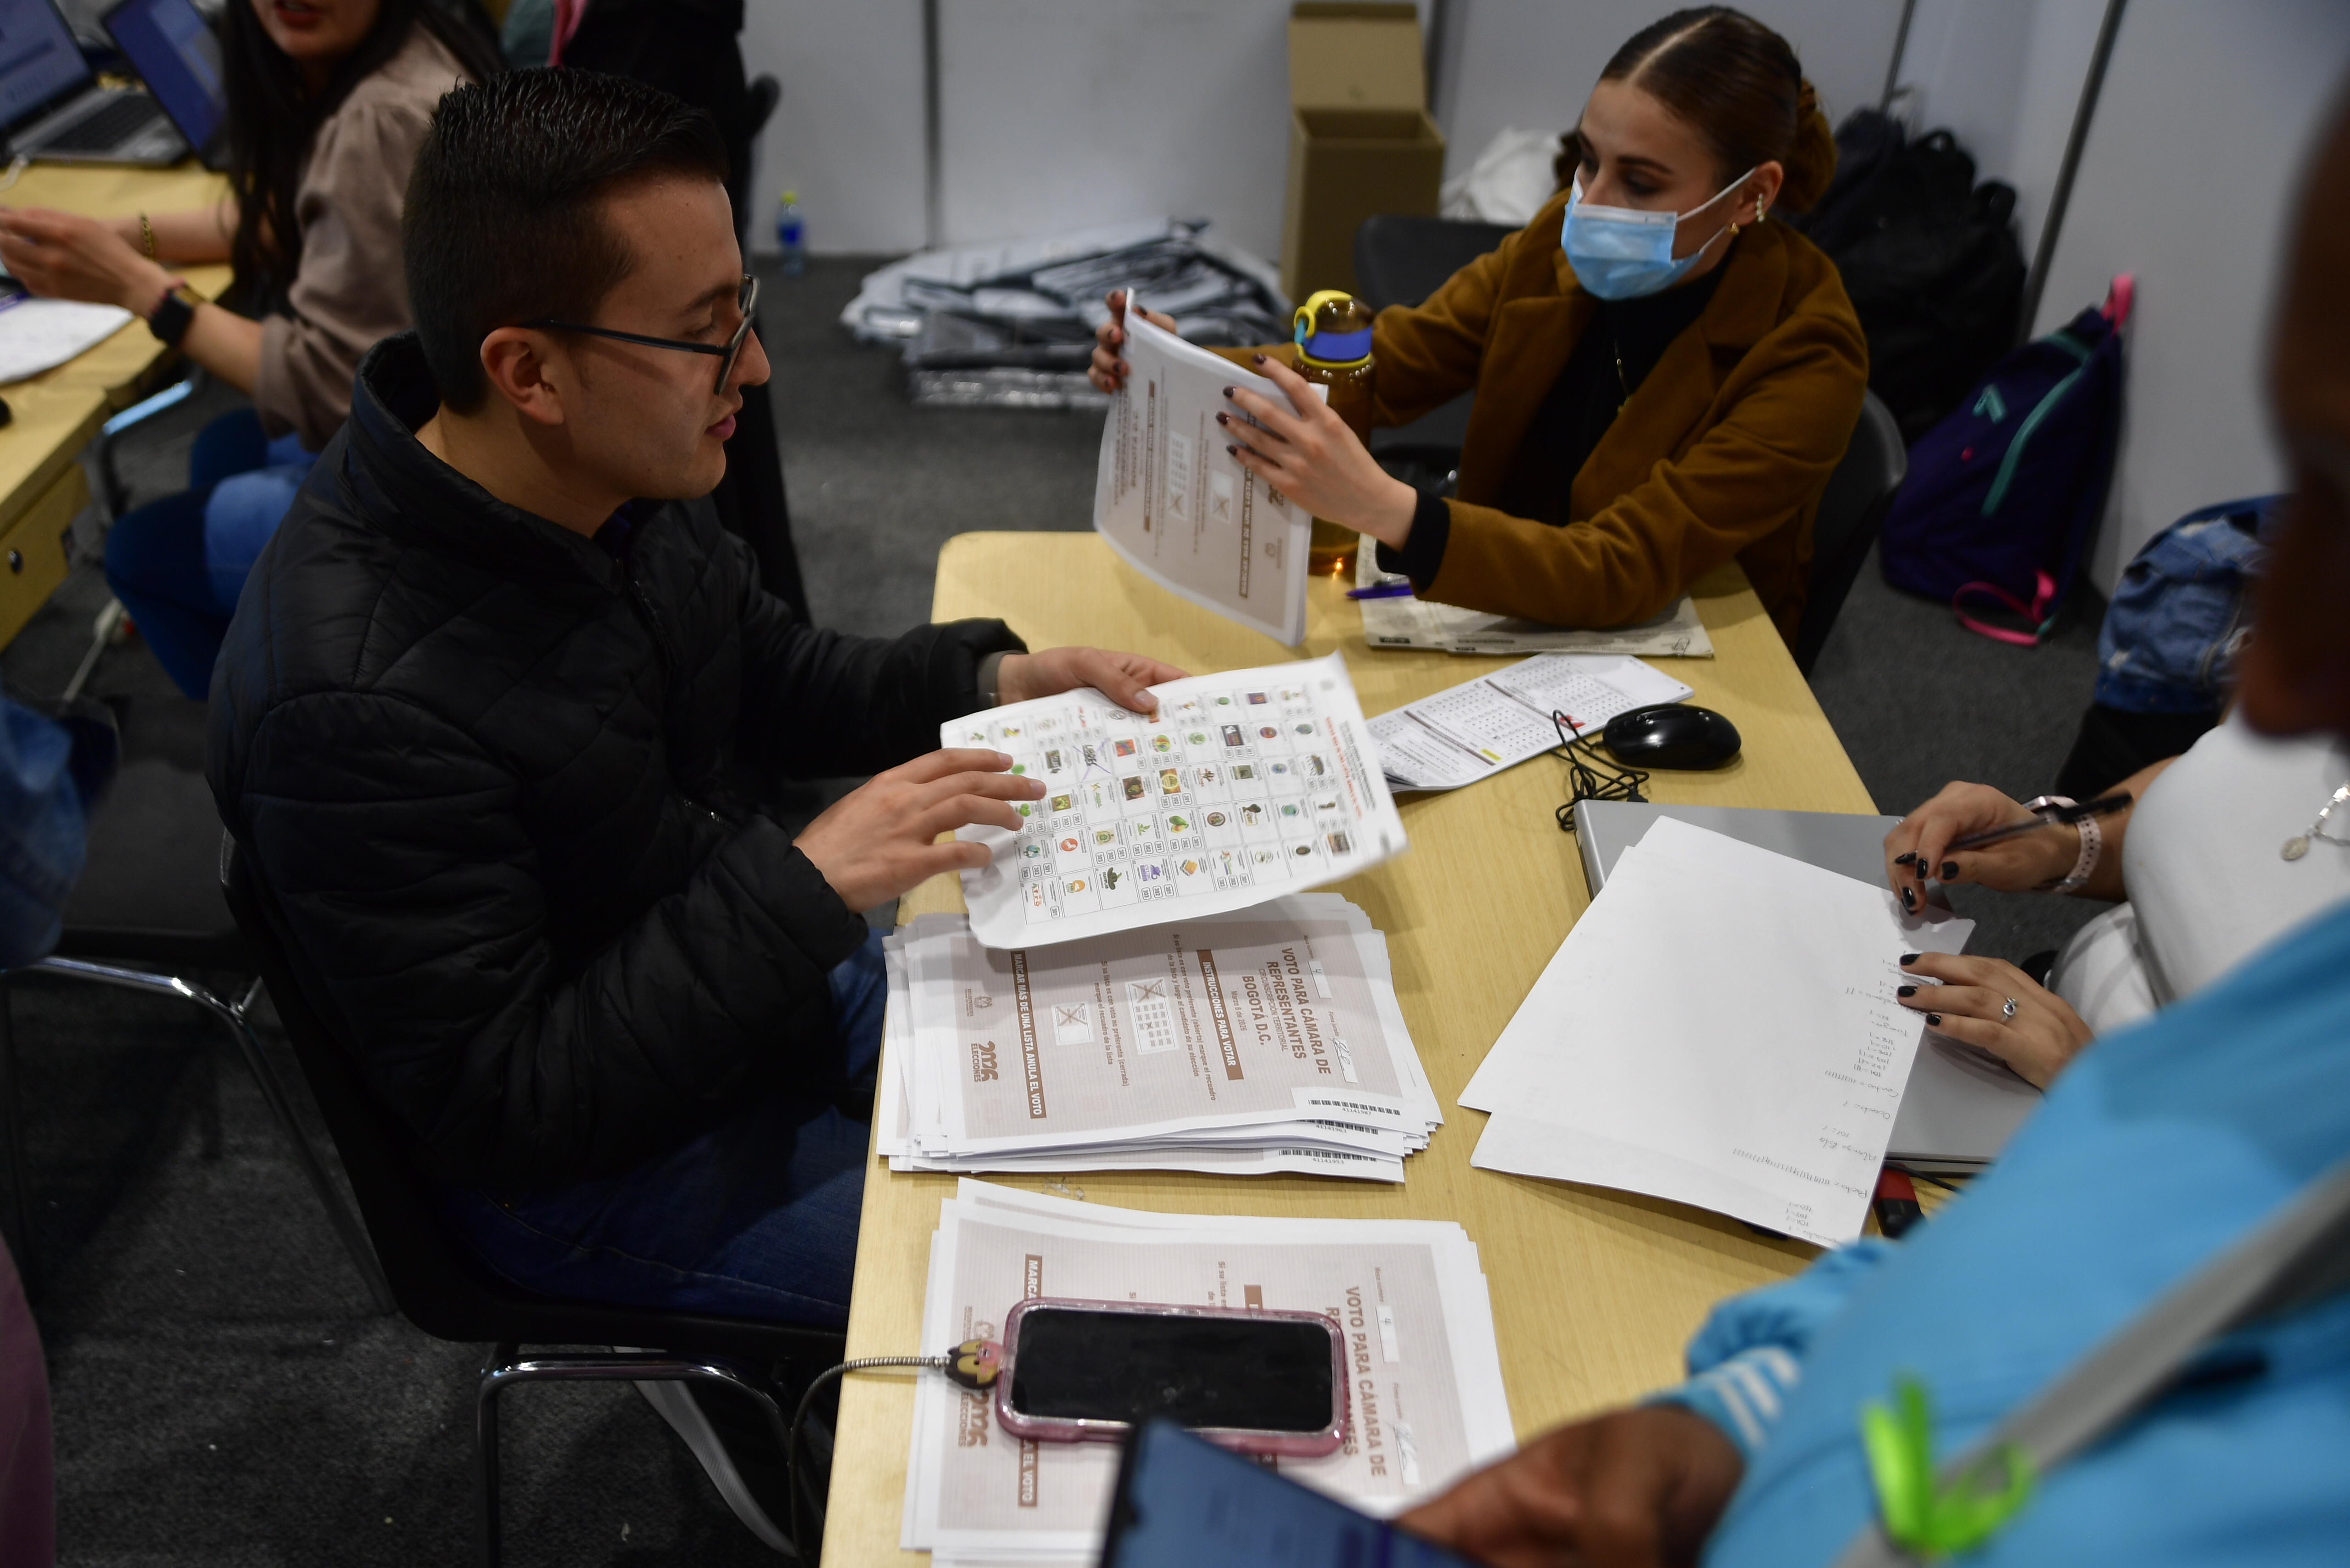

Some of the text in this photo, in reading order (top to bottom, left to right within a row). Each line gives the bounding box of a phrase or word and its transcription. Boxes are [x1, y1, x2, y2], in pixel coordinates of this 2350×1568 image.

[1014, 954, 1042, 1115] MARCAR MÁS DE UNA LISTA ANULA EL VOTO
[1099, 1010, 1108, 1035] recuadro
[1179, 1007, 1190, 1034] candidato
[1189, 1052, 1199, 1077] elección
[1203, 962, 1237, 1066] INSTRUCCIONES PARA VOTAR
[1238, 1019, 1247, 1031] 2026
[1242, 975, 1272, 1046] BOGOTÁ D.C.
[1259, 969, 1289, 1052] CIRCUNSCRIPCIÓN TERRITORIAL
[1267, 961, 1307, 1059] REPRESENTANTES
[1281, 947, 1332, 1074] VOTO PARA CÁMARA DE
[971, 1042, 981, 1082] ELECCIONES
[1112, 1028, 1123, 1058] preferente
[1118, 1059, 1129, 1086] (cerrada)
[1185, 990, 1197, 1018] preferente
[1191, 1019, 1203, 1043] (abierta)
[1198, 1044, 1208, 1066] marque
[1205, 1074, 1216, 1101] recuadro
[1027, 1259, 1038, 1299] MARCA
[1208, 1291, 1215, 1300] de
[1219, 1270, 1225, 1279] su
[1345, 1286, 1387, 1477] VOTO PARA CÁMARA DE
[1022, 1472, 1033, 1501] VOTO
[1023, 1453, 1034, 1467] EL
